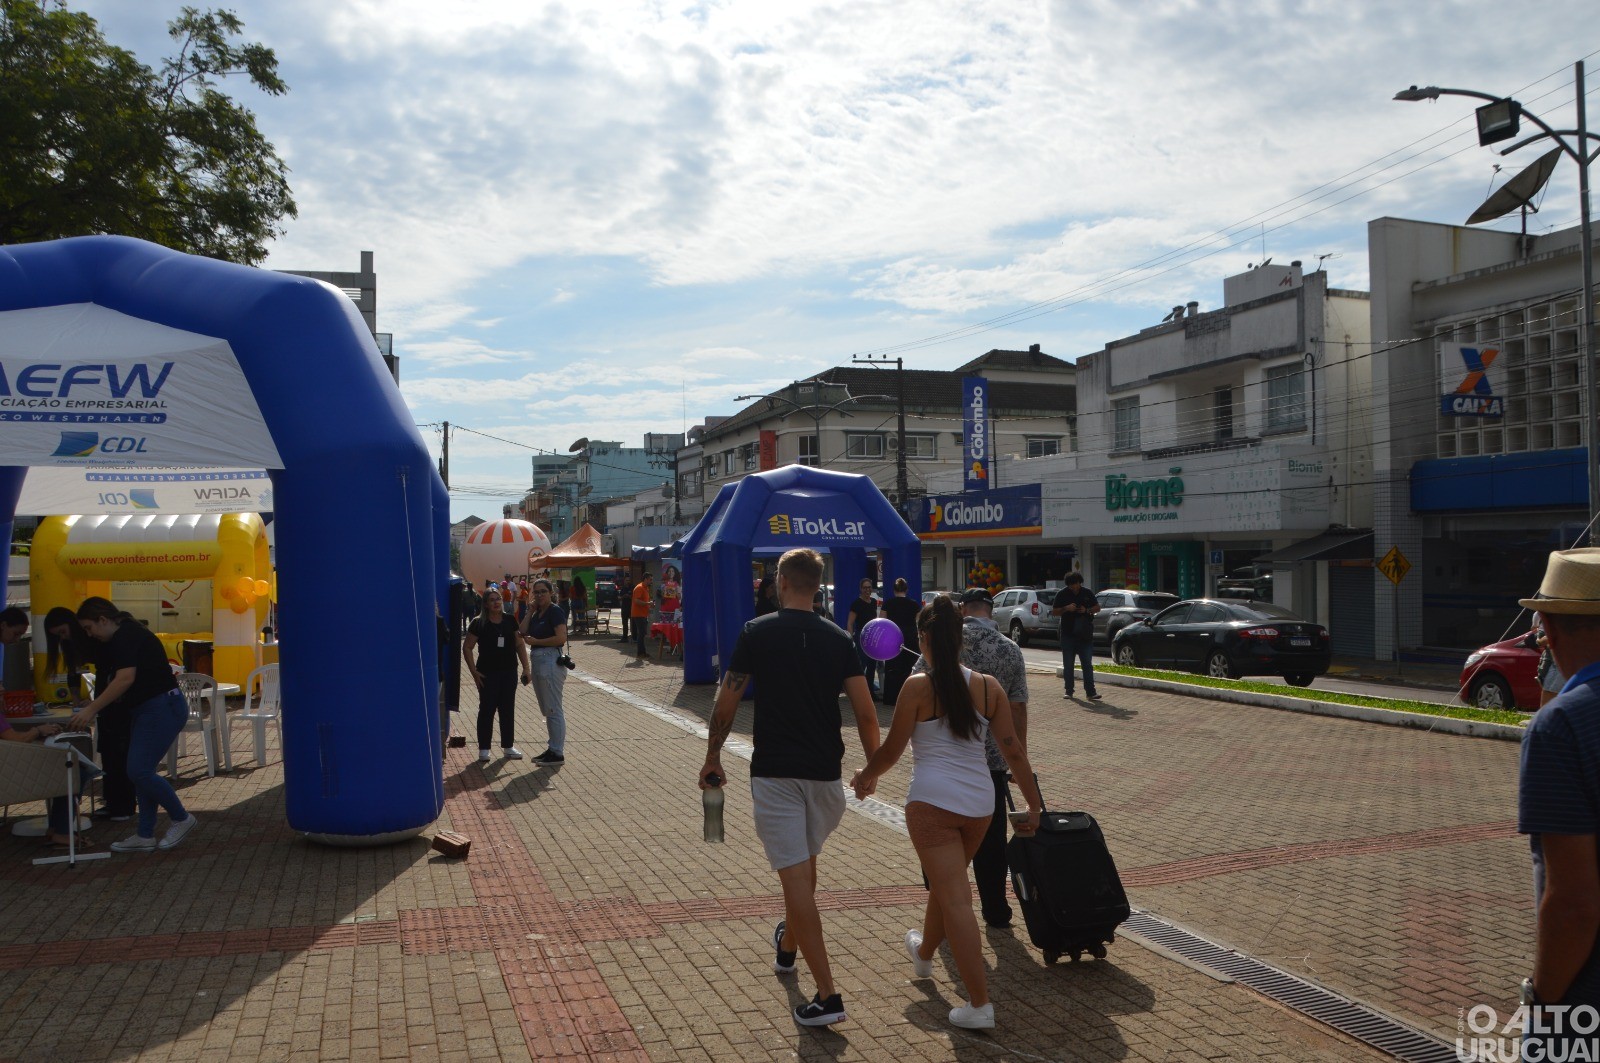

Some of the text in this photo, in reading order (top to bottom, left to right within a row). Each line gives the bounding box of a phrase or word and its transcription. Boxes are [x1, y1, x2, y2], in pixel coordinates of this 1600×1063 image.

[65, 400, 168, 409] EMPRESARIAL
[1452, 397, 1501, 414] CAIXA
[32, 413, 161, 423] WESTPHALEN
[971, 385, 984, 460] Colombo
[100, 437, 148, 453] CDL
[943, 498, 1004, 526] Colombo
[792, 517, 866, 536] TokLar
[69, 552, 211, 565] www.verointernet.com.br
